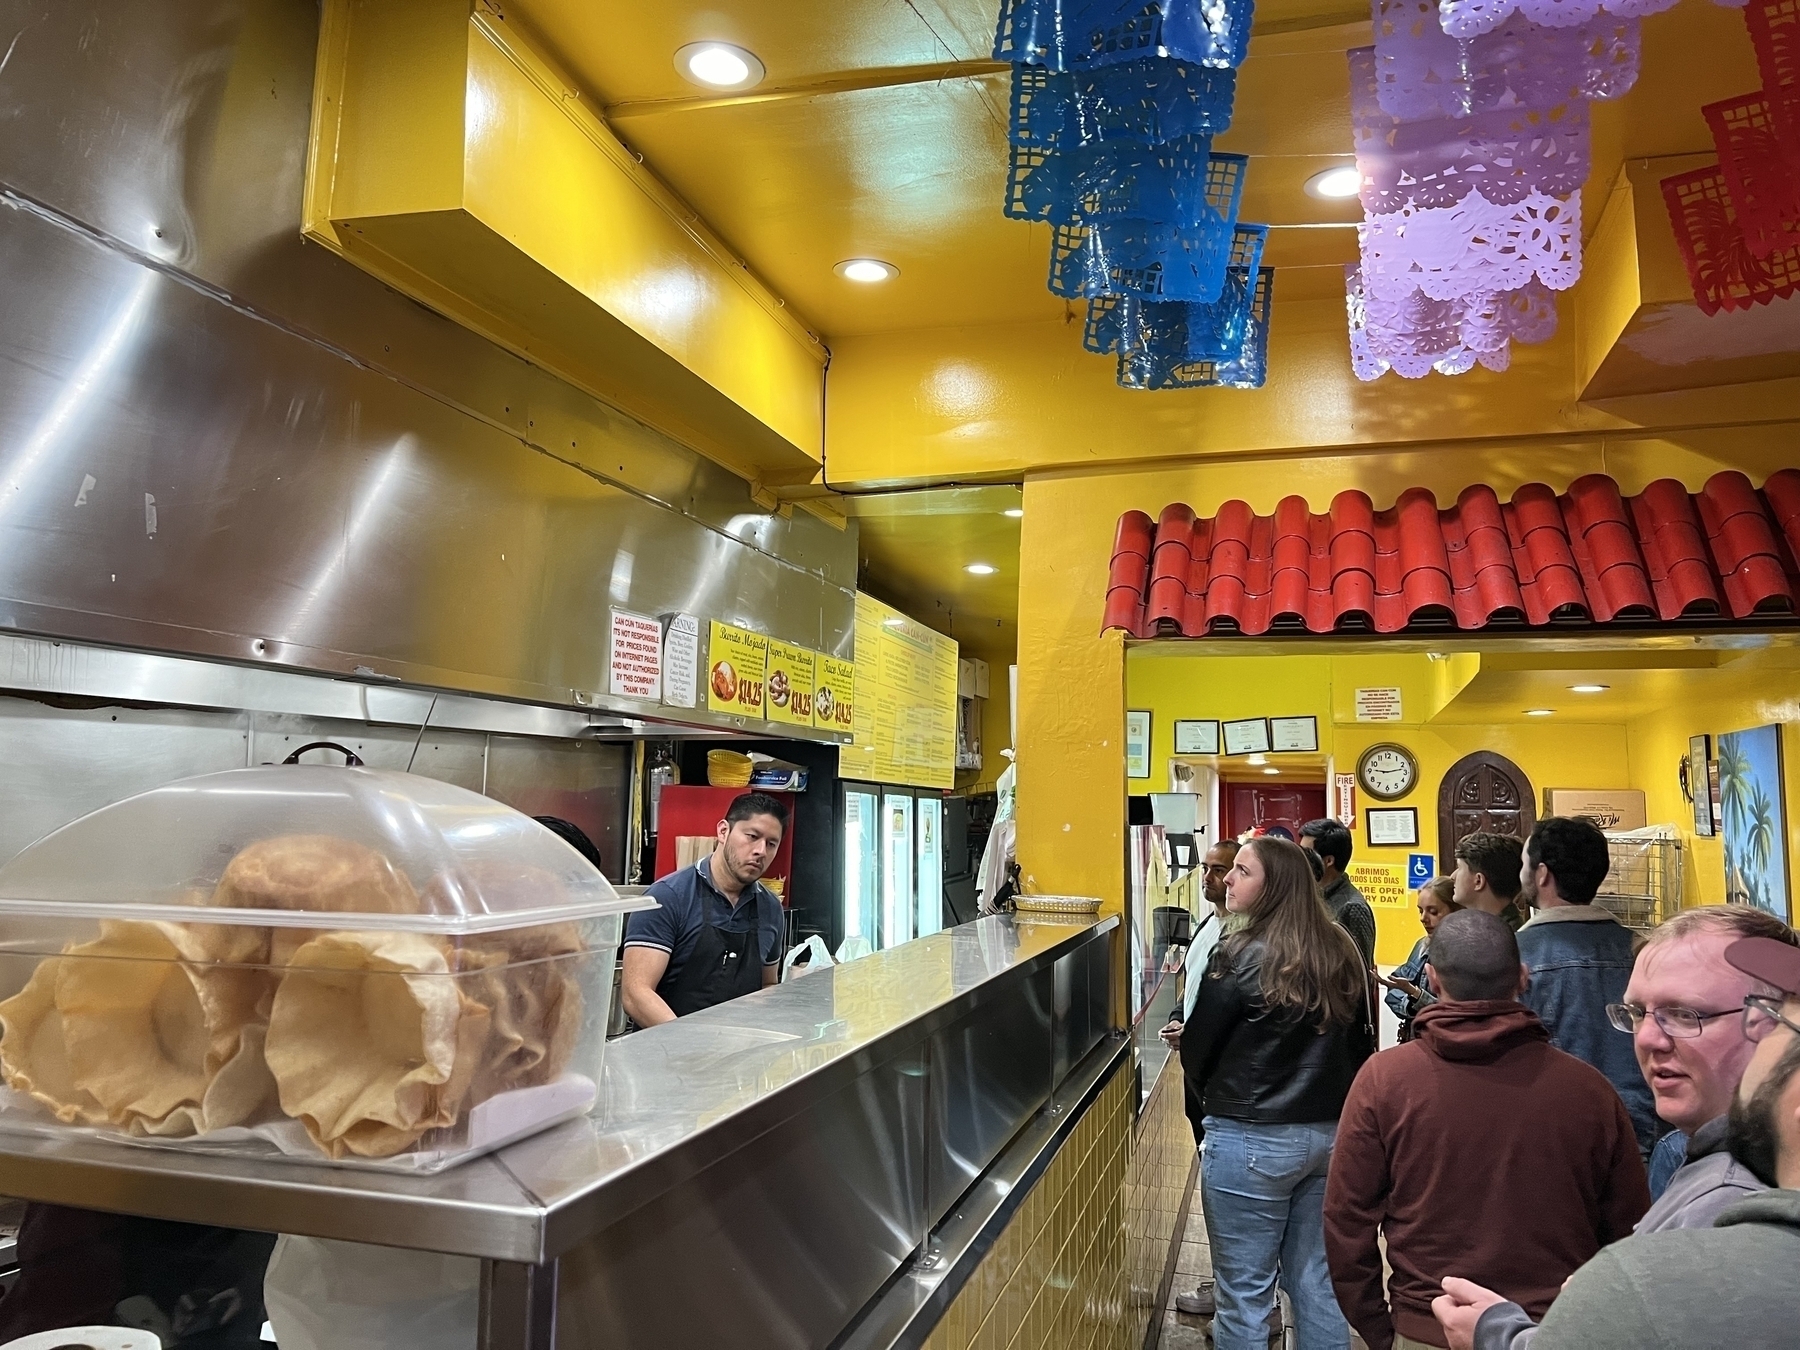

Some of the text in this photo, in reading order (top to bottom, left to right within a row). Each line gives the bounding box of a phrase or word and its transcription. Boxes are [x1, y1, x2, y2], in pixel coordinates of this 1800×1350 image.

[615, 617, 625, 626] CAN
[673, 618, 695, 633] ARNING:
[621, 629, 630, 638] NOT
[630, 631, 659, 644] RESPONSIBLE
[719, 626, 766, 651] Burrito Mojado
[615, 639, 657, 654] FOR PRICES FOUND
[614, 650, 658, 664] ON INTERNET PAGES
[768, 643, 782, 659] Super
[796, 652, 813, 666] Burrito
[612, 661, 660, 675] AND NOT AUTHORIZED
[823, 659, 854, 679] Taco Salad
[616, 673, 623, 681] BY
[623, 673, 634, 683] THIS
[623, 685, 649, 695] THANK YOU
[738, 677, 763, 706] $14.25
[790, 689, 811, 716] $14.25
[835, 700, 852, 725] $14.25
[1337, 777, 1354, 785] FIRE
[1350, 875, 1367, 883] ODOS
[1355, 868, 1389, 876] ABRIMOS
[1379, 887, 1404, 895] OPEN
